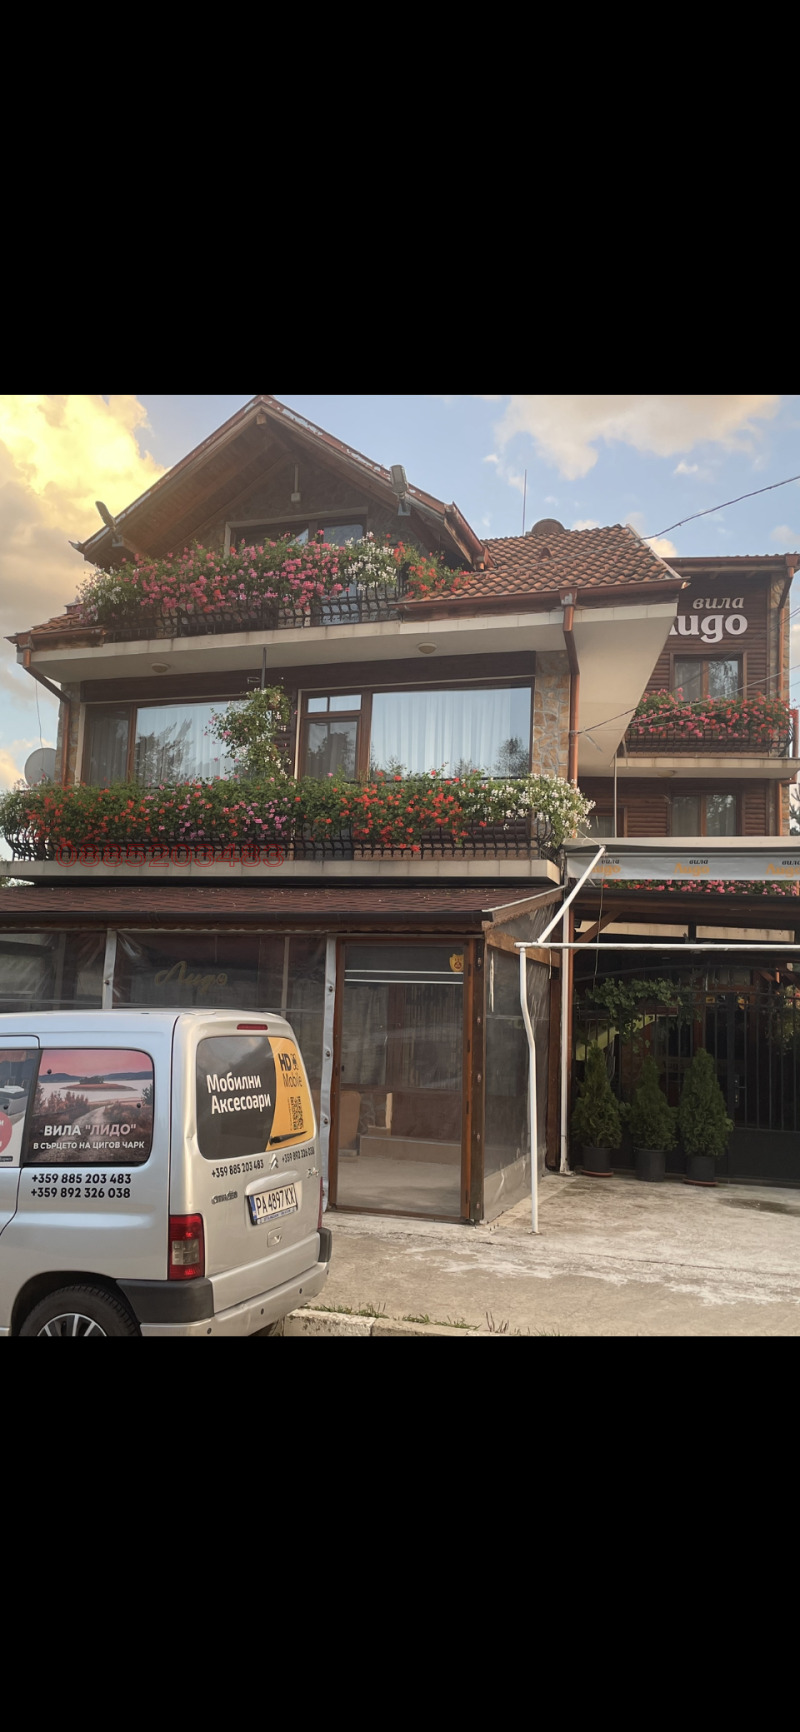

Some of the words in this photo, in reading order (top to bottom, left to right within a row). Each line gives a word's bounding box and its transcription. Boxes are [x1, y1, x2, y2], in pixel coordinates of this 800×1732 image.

[692, 597, 744, 609] вила
[674, 862, 710, 876] Лидо
[278, 1053, 291, 1071] HD
[206, 1072, 261, 1093] Мобилни
[211, 1094, 271, 1114] Аксесоари
[44, 1125, 81, 1136] ВИЛА
[85, 1124, 136, 1136] "ЛИДО"
[93, 1142, 120, 1150] ЦИГОВ
[212, 1167, 228, 1178] +359
[229, 1163, 241, 1175] 885
[242, 1161, 252, 1172] 203
[253, 1159, 264, 1169] 483
[32, 1174, 58, 1184] +359
[61, 1174, 82, 1184] 885
[85, 1174, 107, 1184] 203
[110, 1174, 131, 1184] 483
[31, 1188, 57, 1198] +359
[60, 1188, 81, 1198] 892
[84, 1188, 105, 1198] 326
[108, 1188, 130, 1198] 038
